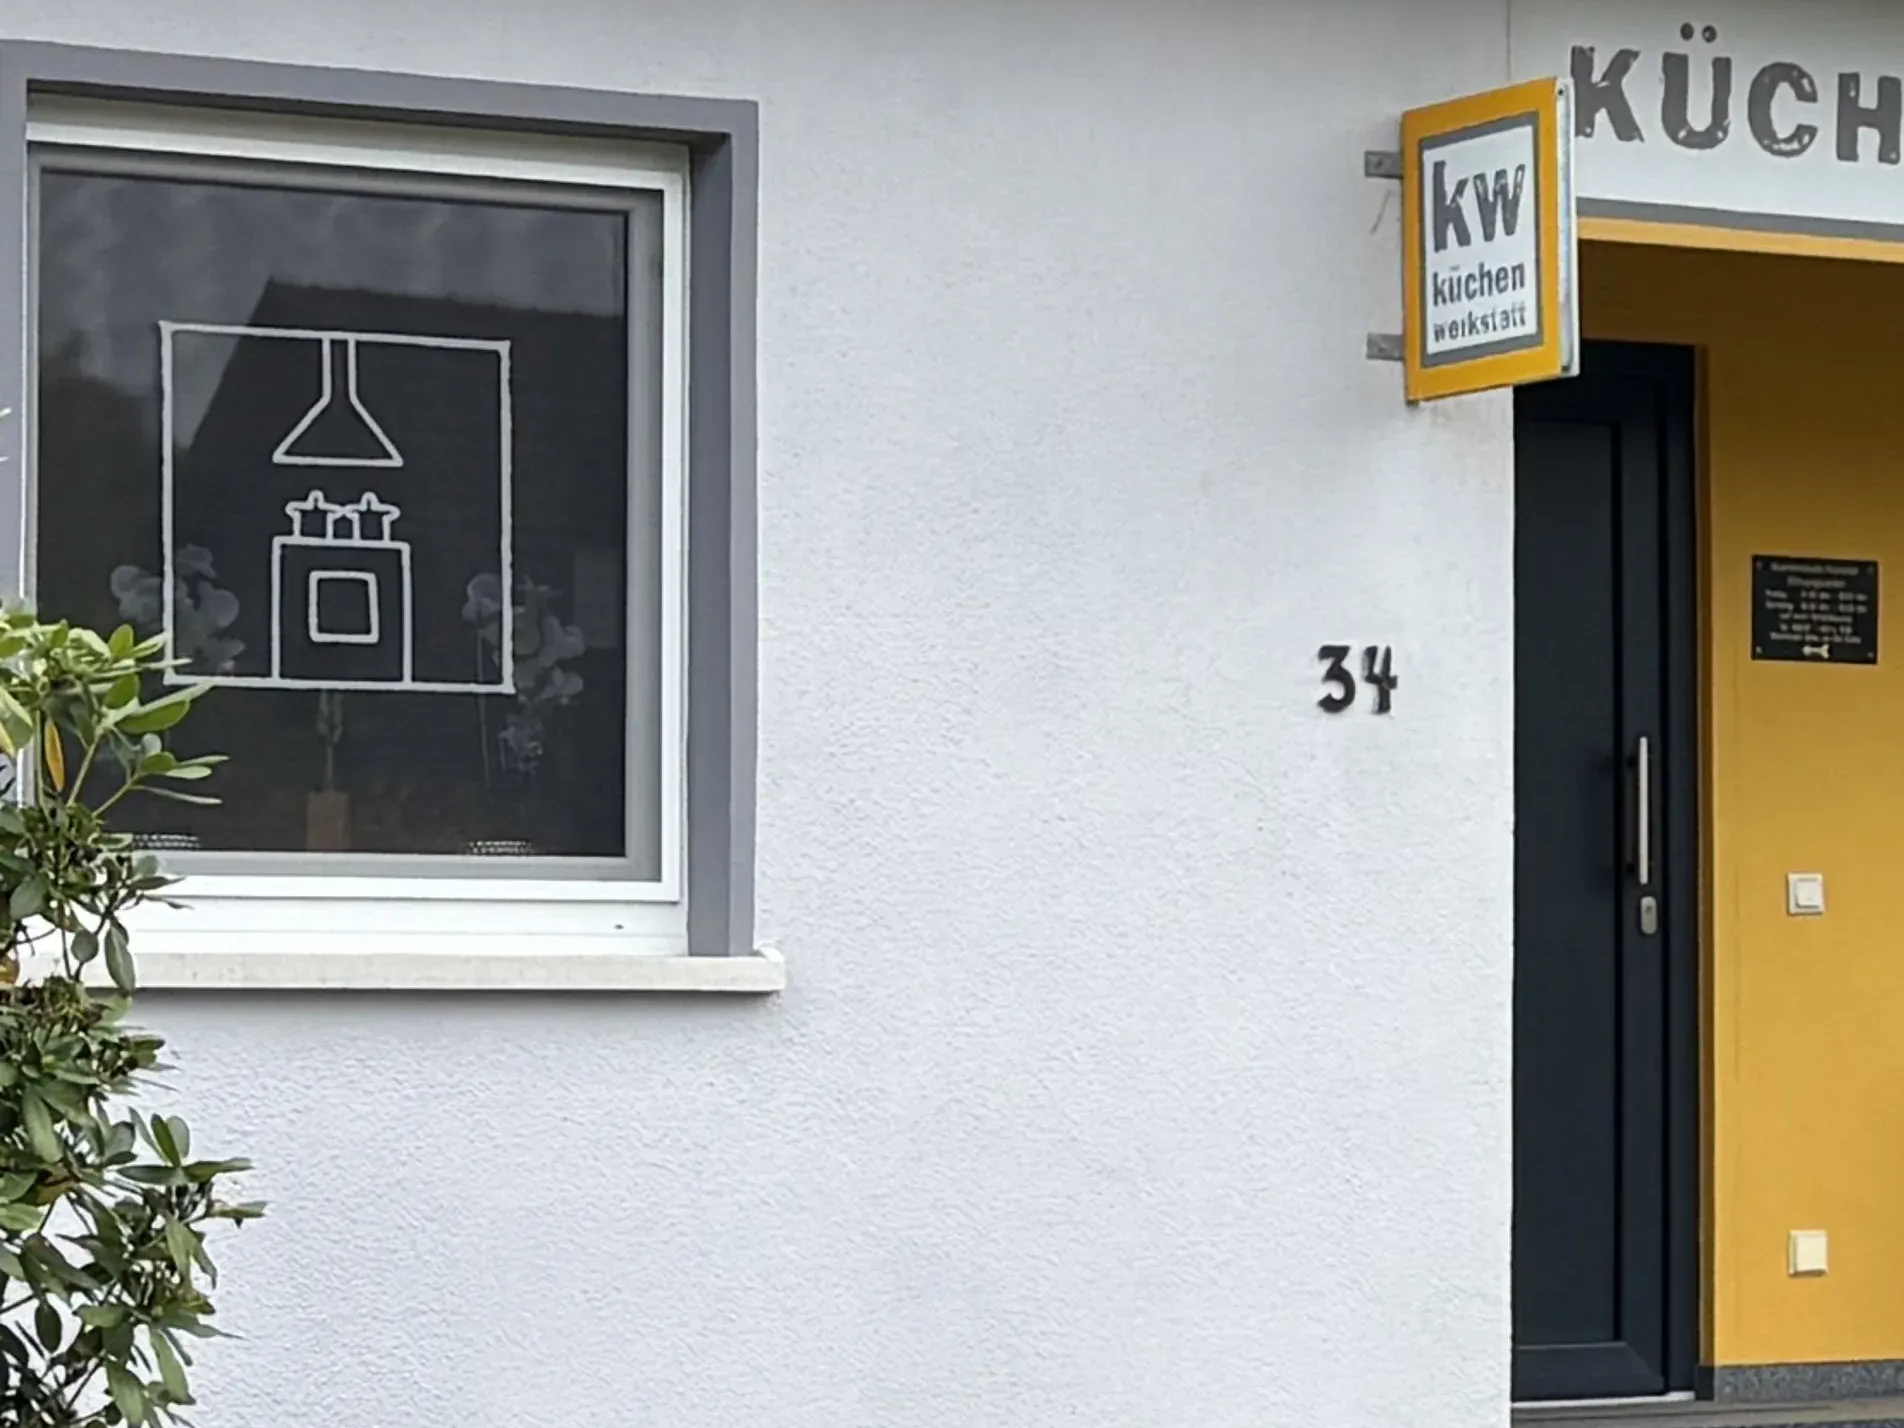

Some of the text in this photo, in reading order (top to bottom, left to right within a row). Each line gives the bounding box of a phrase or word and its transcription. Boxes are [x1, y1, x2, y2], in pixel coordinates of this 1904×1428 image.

[1432, 159, 1526, 253] kw
[1432, 261, 1526, 308] küchen
[1433, 302, 1527, 343] werkstatt
[1315, 644, 1399, 715] 34
